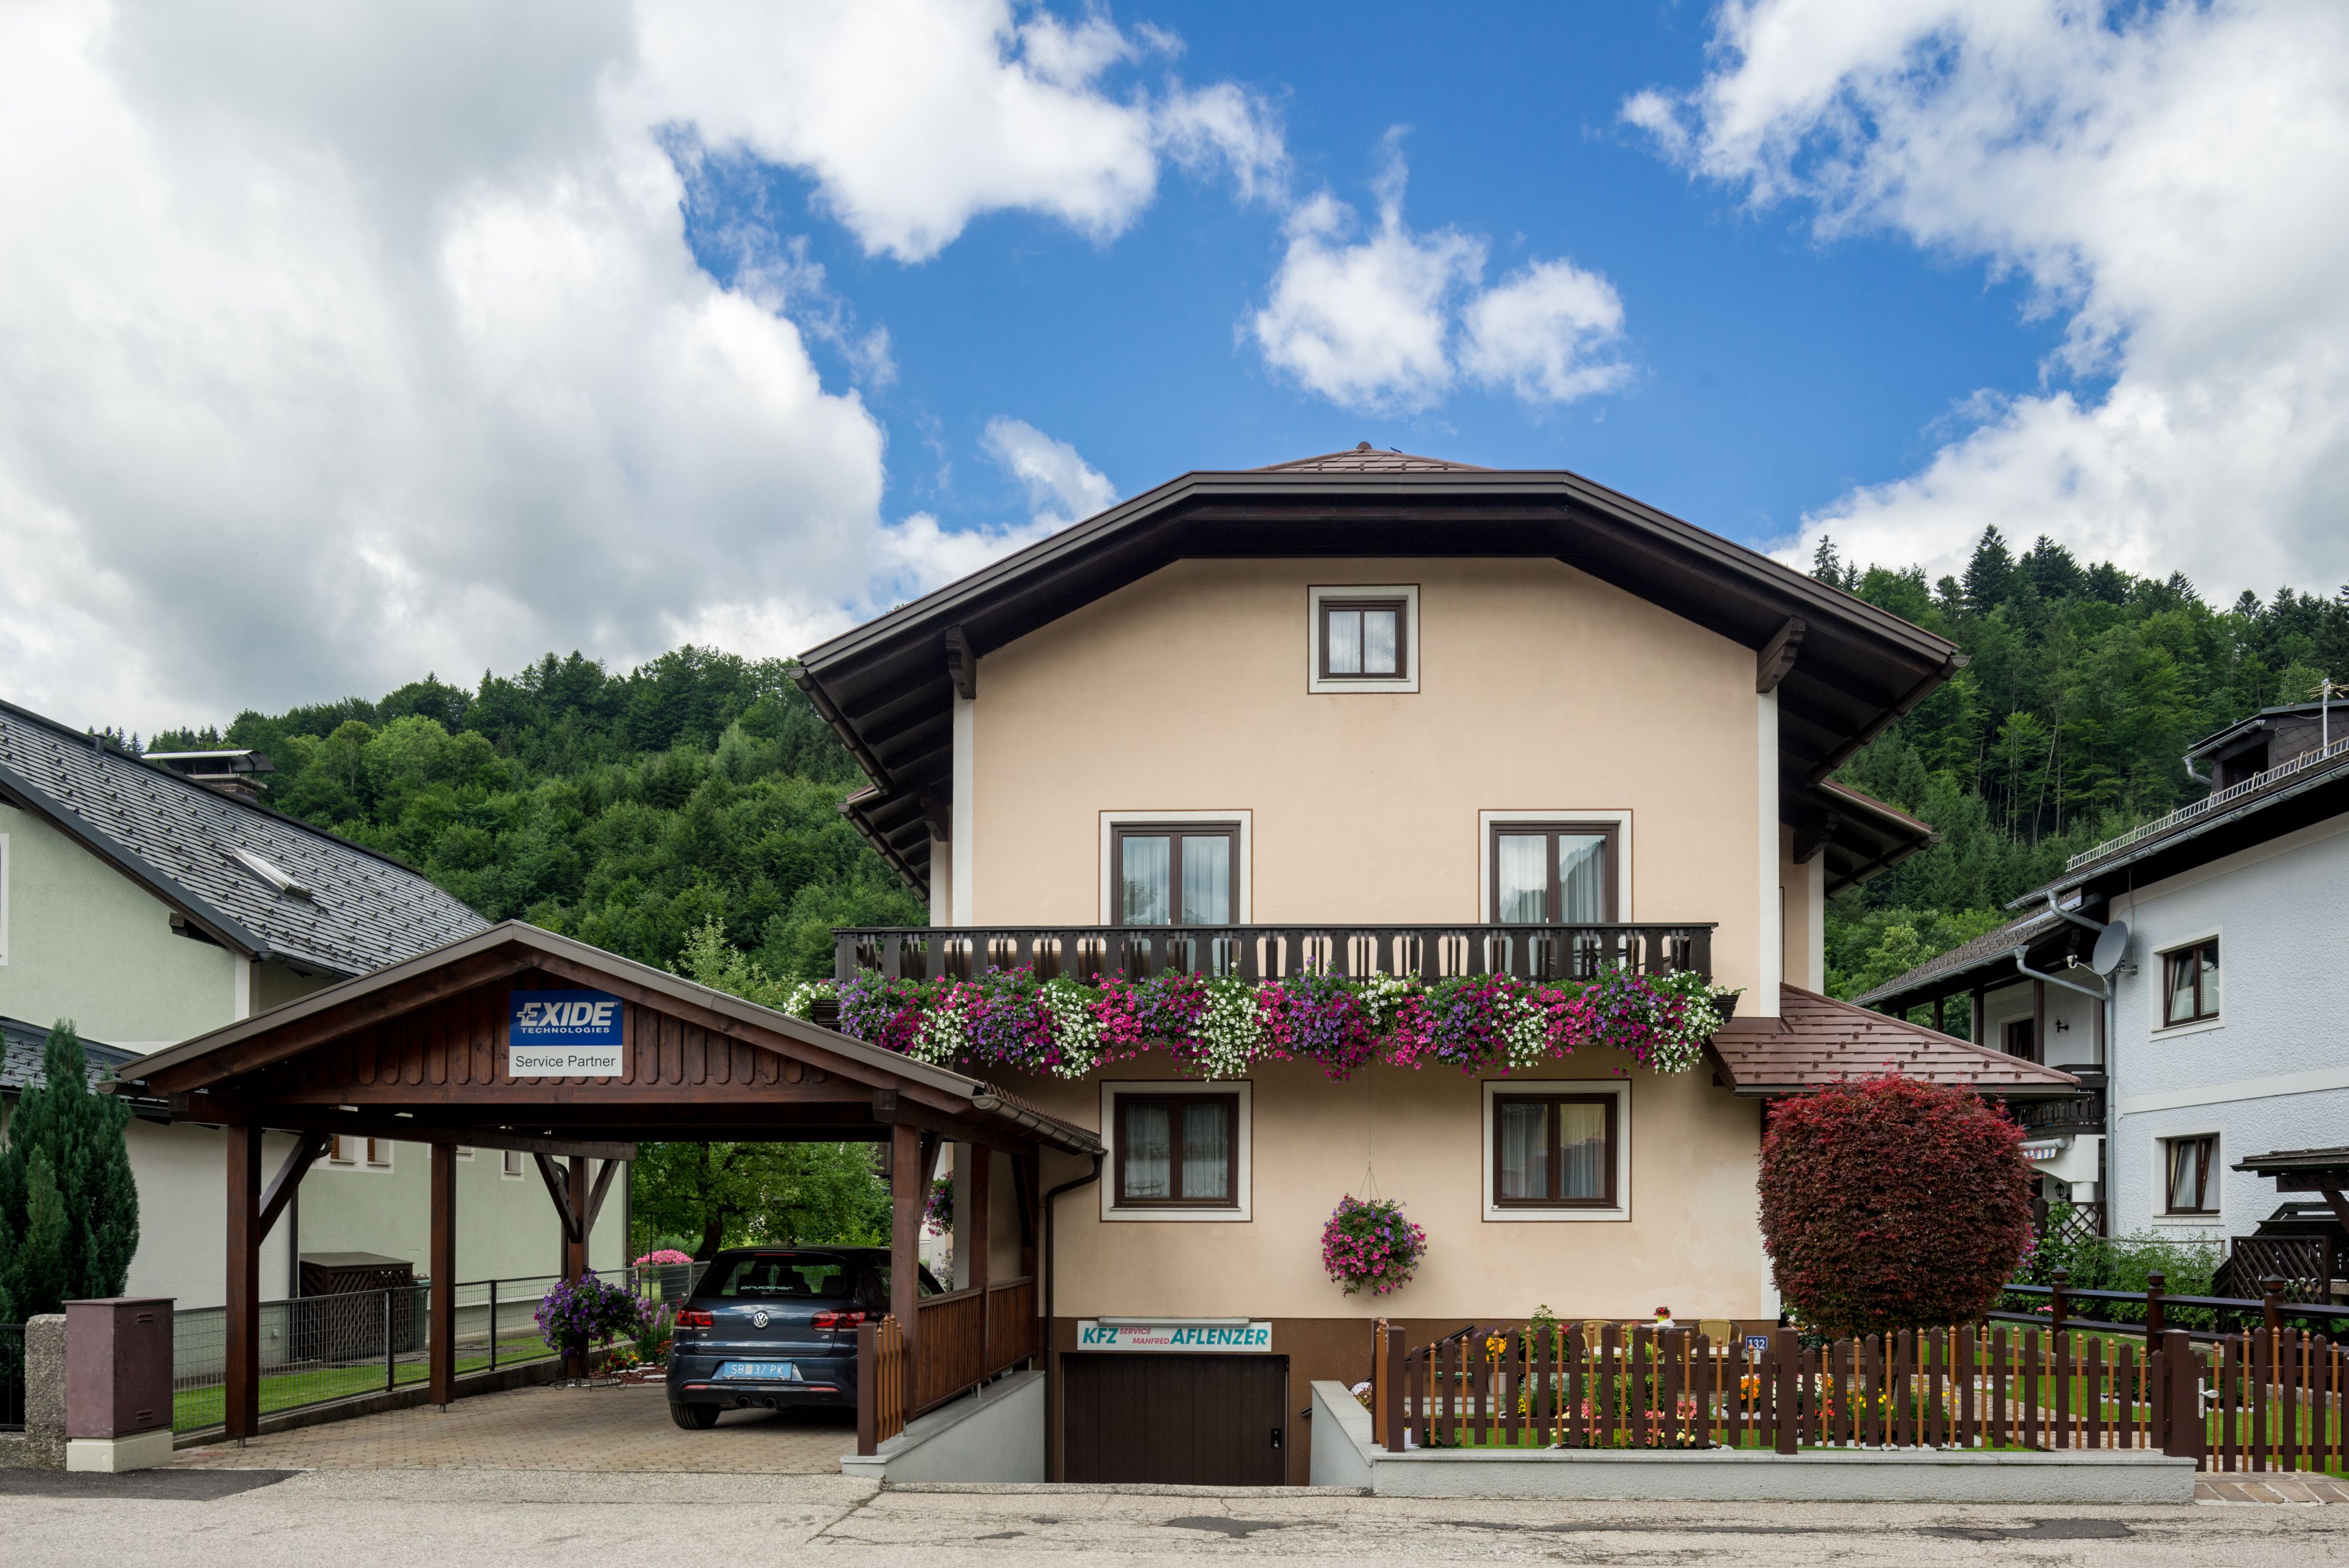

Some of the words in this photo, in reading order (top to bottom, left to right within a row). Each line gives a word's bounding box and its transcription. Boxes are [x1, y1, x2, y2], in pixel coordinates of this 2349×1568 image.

[516, 1002, 615, 1027] EXIDE
[515, 1055, 563, 1067] Service
[568, 1055, 616, 1067] Partner
[1082, 1327, 1119, 1344] KFZ
[1169, 1328, 1268, 1345] AFLENZER
[1748, 1339, 1765, 1350] 132
